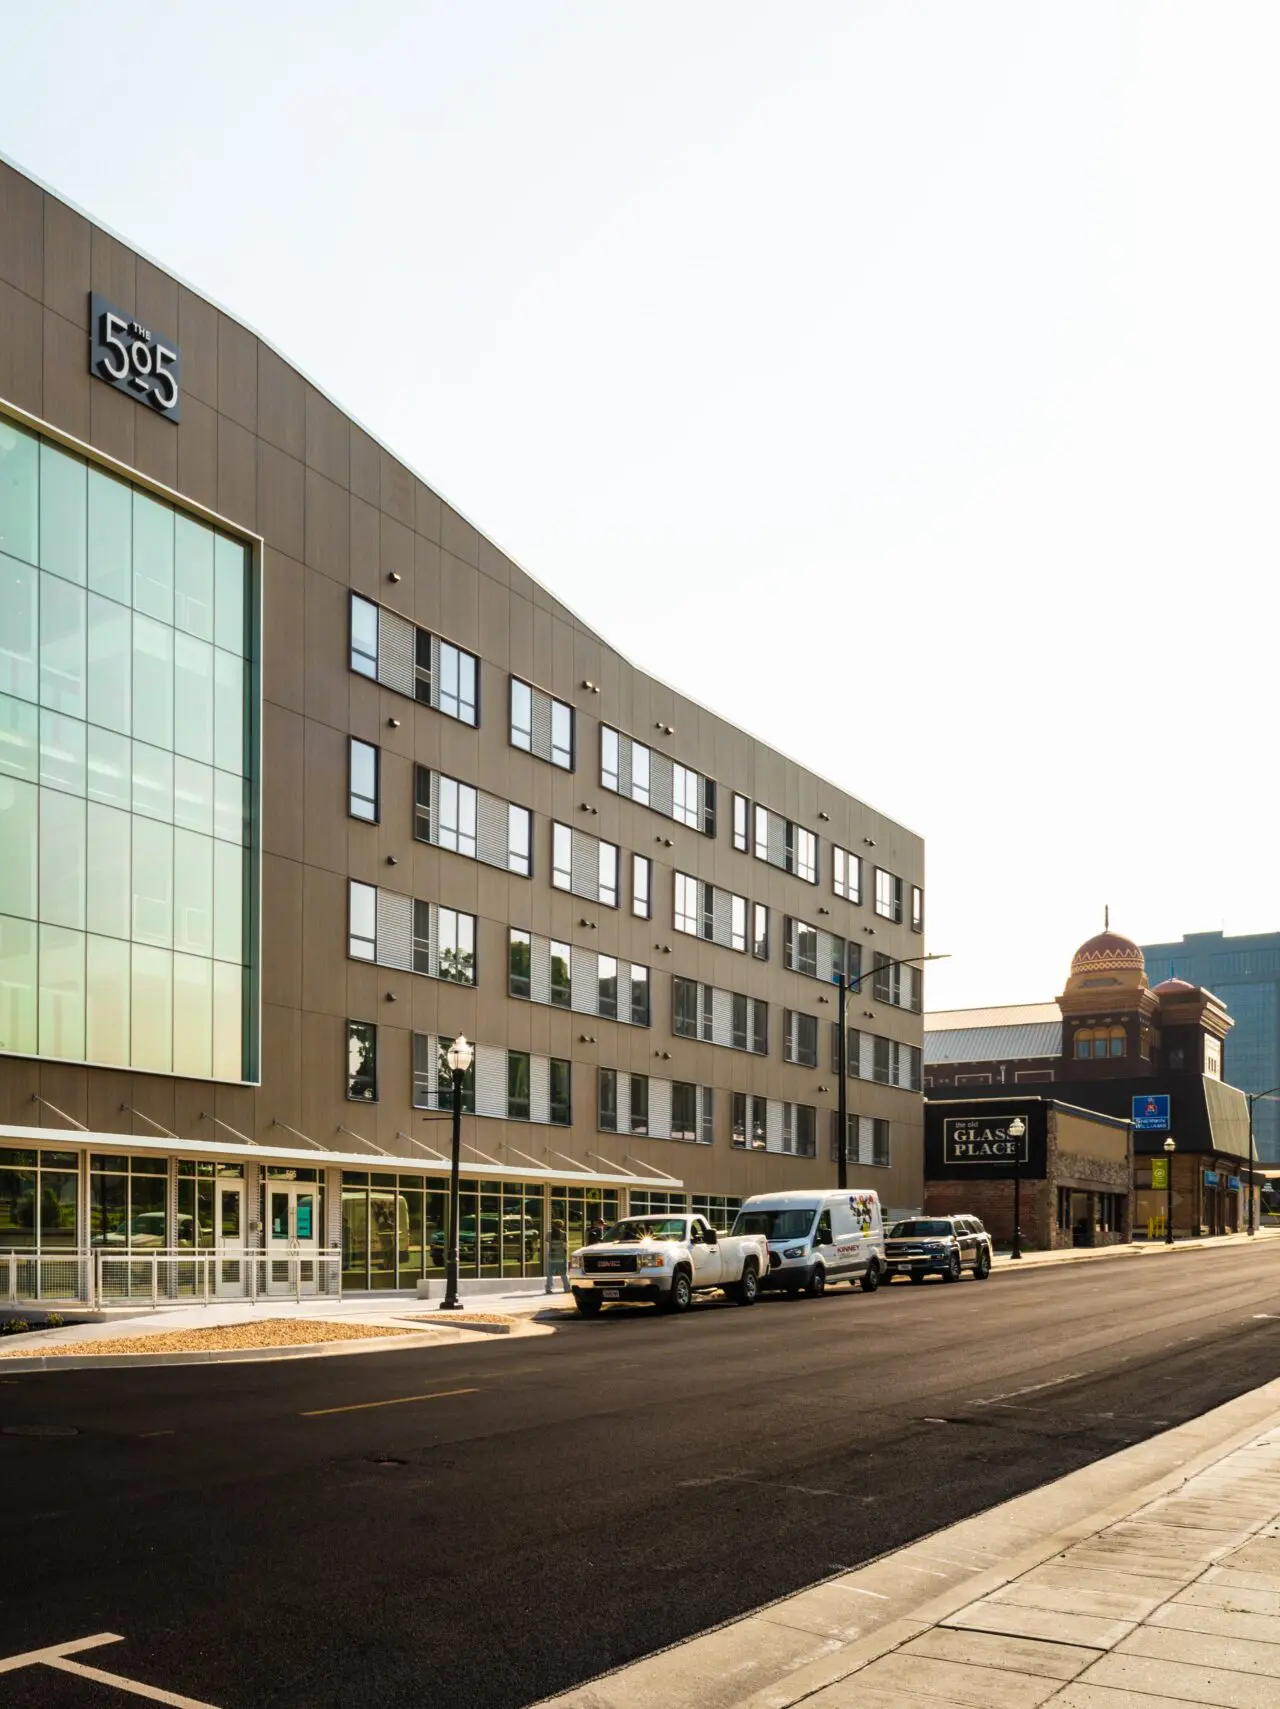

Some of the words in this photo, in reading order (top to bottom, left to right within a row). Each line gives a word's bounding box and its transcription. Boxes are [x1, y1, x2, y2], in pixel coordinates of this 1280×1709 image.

[133, 321, 151, 341] THE
[103, 311, 178, 409] 505
[953, 1142, 1017, 1156] PLACE
[837, 1244, 860, 1253] KINNEY
[597, 1260, 620, 1268] GMC
